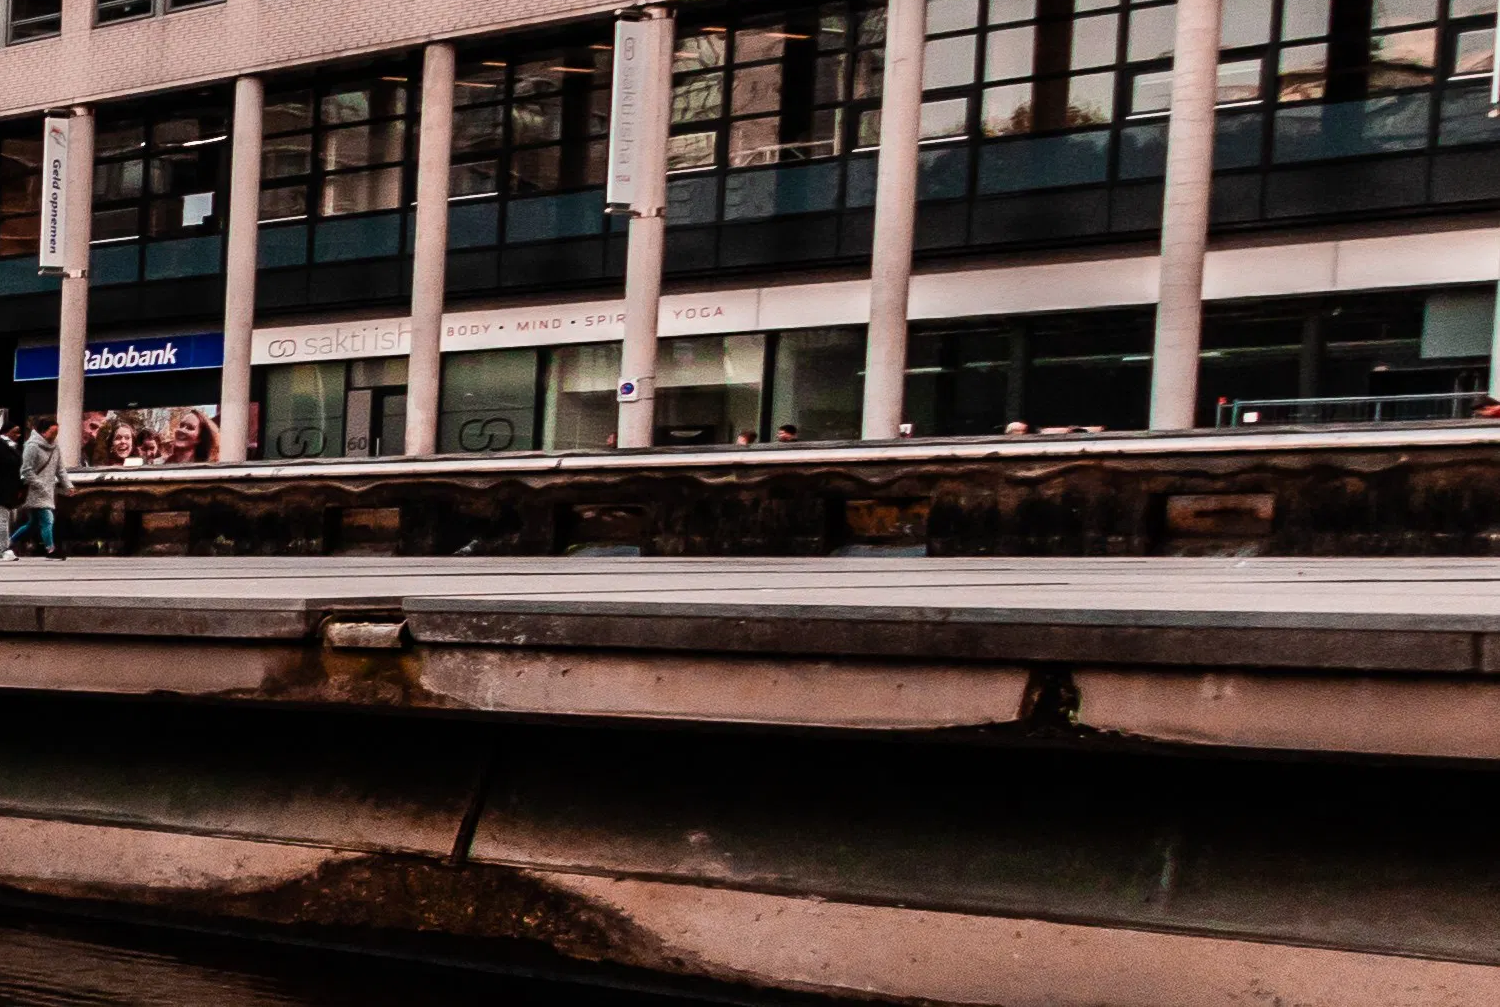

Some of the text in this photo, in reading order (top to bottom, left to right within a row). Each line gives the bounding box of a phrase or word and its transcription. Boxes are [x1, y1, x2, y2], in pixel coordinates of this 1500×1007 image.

[48, 159, 63, 254] Geld opnemen
[446, 306, 725, 337] BODY MIND SPIR YOGA
[304, 321, 412, 356] sakti ish
[346, 436, 368, 452] 60
